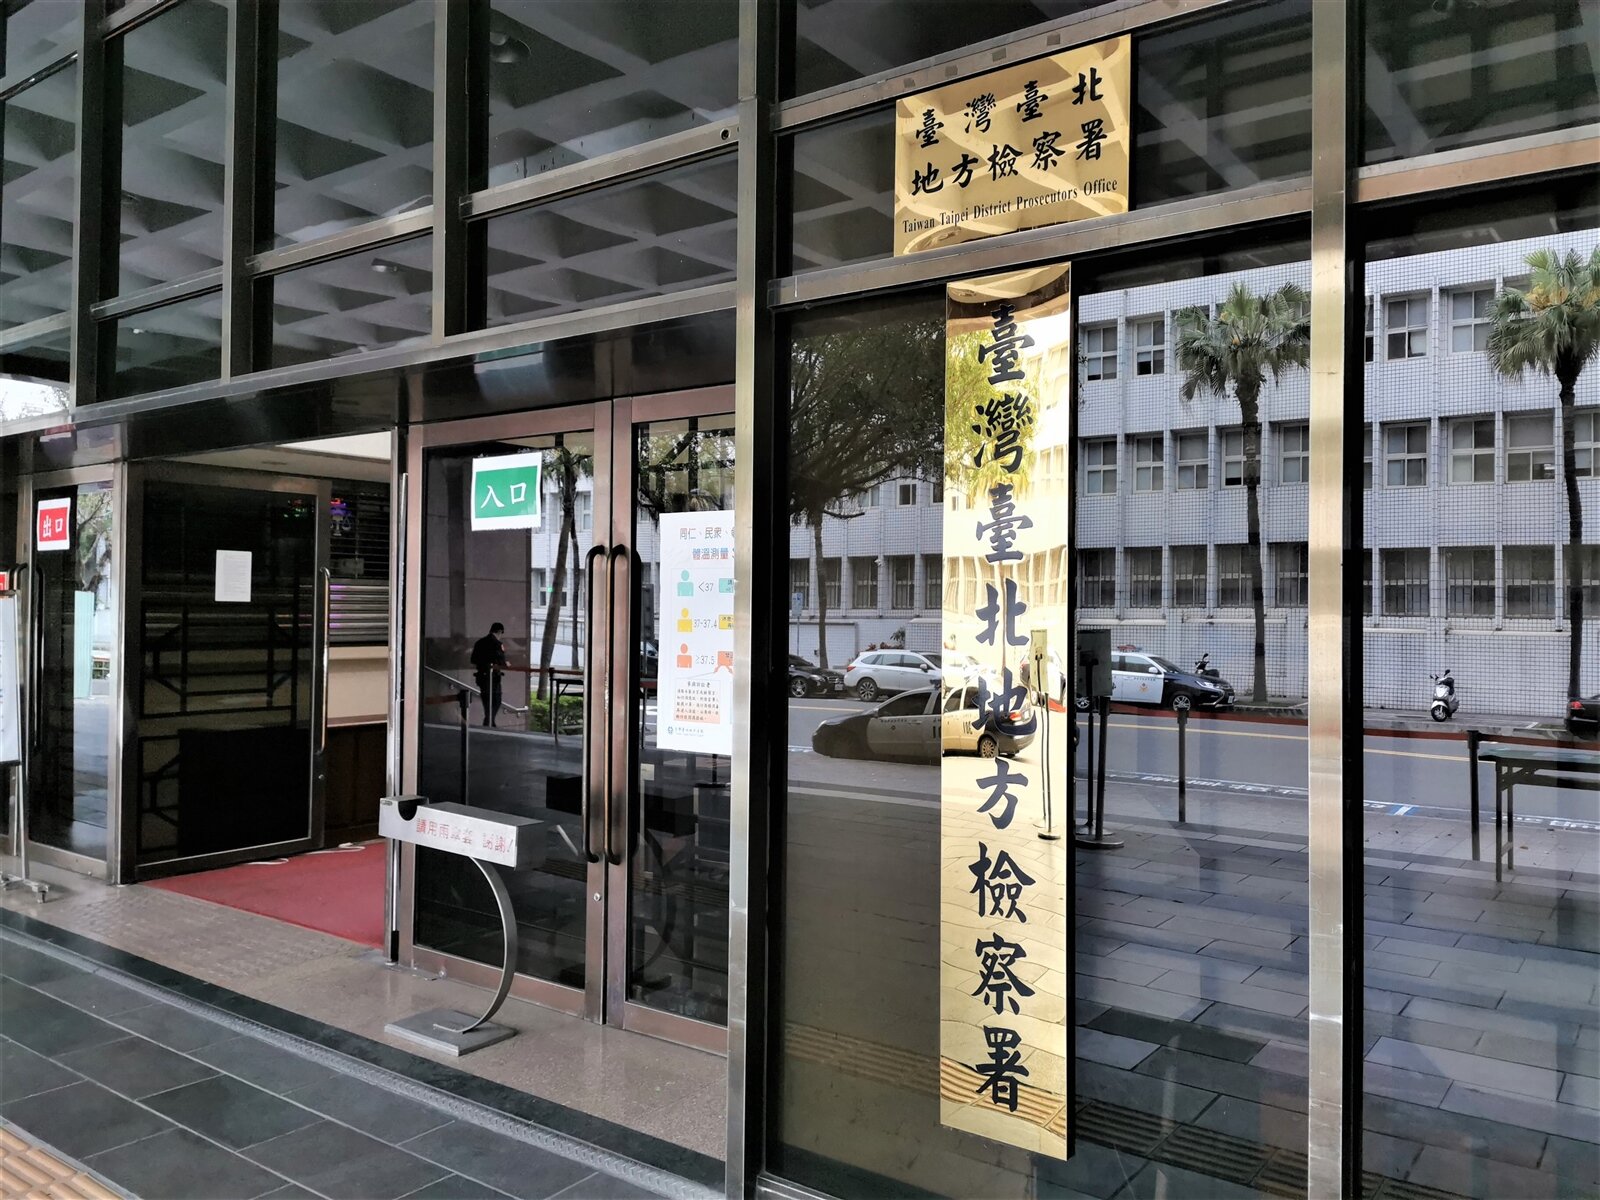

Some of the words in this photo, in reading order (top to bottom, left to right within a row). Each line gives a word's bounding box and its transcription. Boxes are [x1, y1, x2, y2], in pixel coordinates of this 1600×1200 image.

[915, 67, 1104, 149] 臺灣臺北
[911, 118, 1107, 196] 地方檢察署
[903, 218, 935, 233] Taiwan
[940, 207, 969, 226] Taipei
[973, 201, 1011, 219] District
[1016, 188, 1078, 210] Prosecutors
[1083, 178, 1118, 196] Office
[42, 515, 64, 538] 出口
[480, 482, 527, 509] 入口
[969, 303, 1037, 1113] 臺灣臺北地方檢察署
